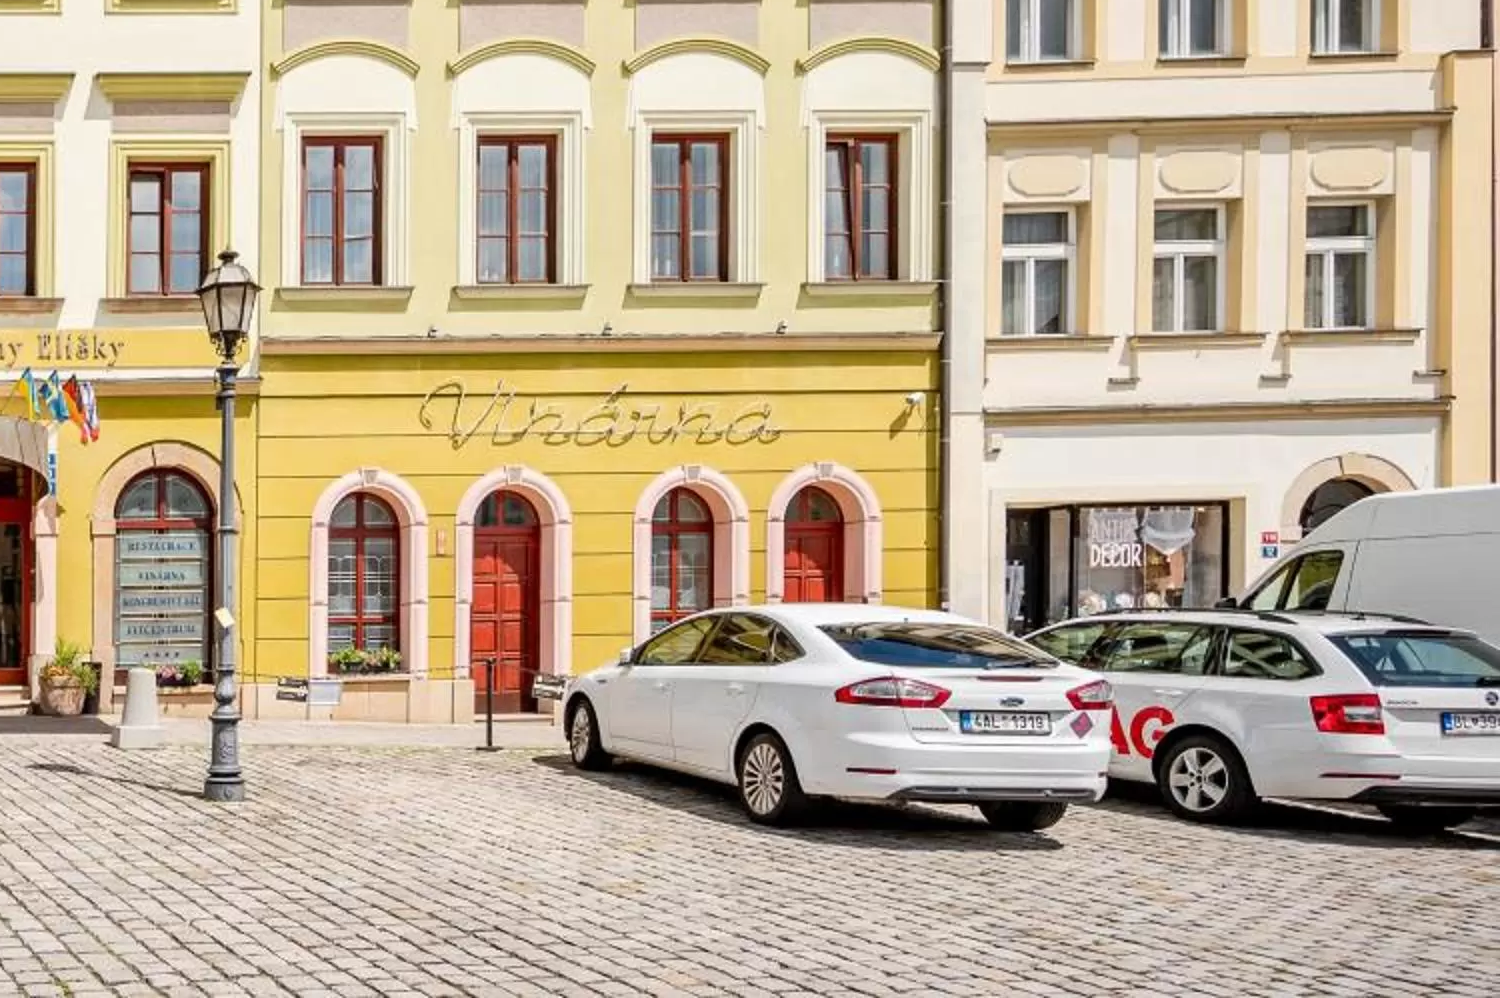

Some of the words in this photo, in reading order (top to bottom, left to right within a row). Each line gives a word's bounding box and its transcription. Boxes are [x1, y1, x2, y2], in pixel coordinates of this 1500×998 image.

[37, 333, 125, 368] Elišky
[419, 378, 781, 450] Vinárna
[1090, 543, 1143, 568] DECOR
